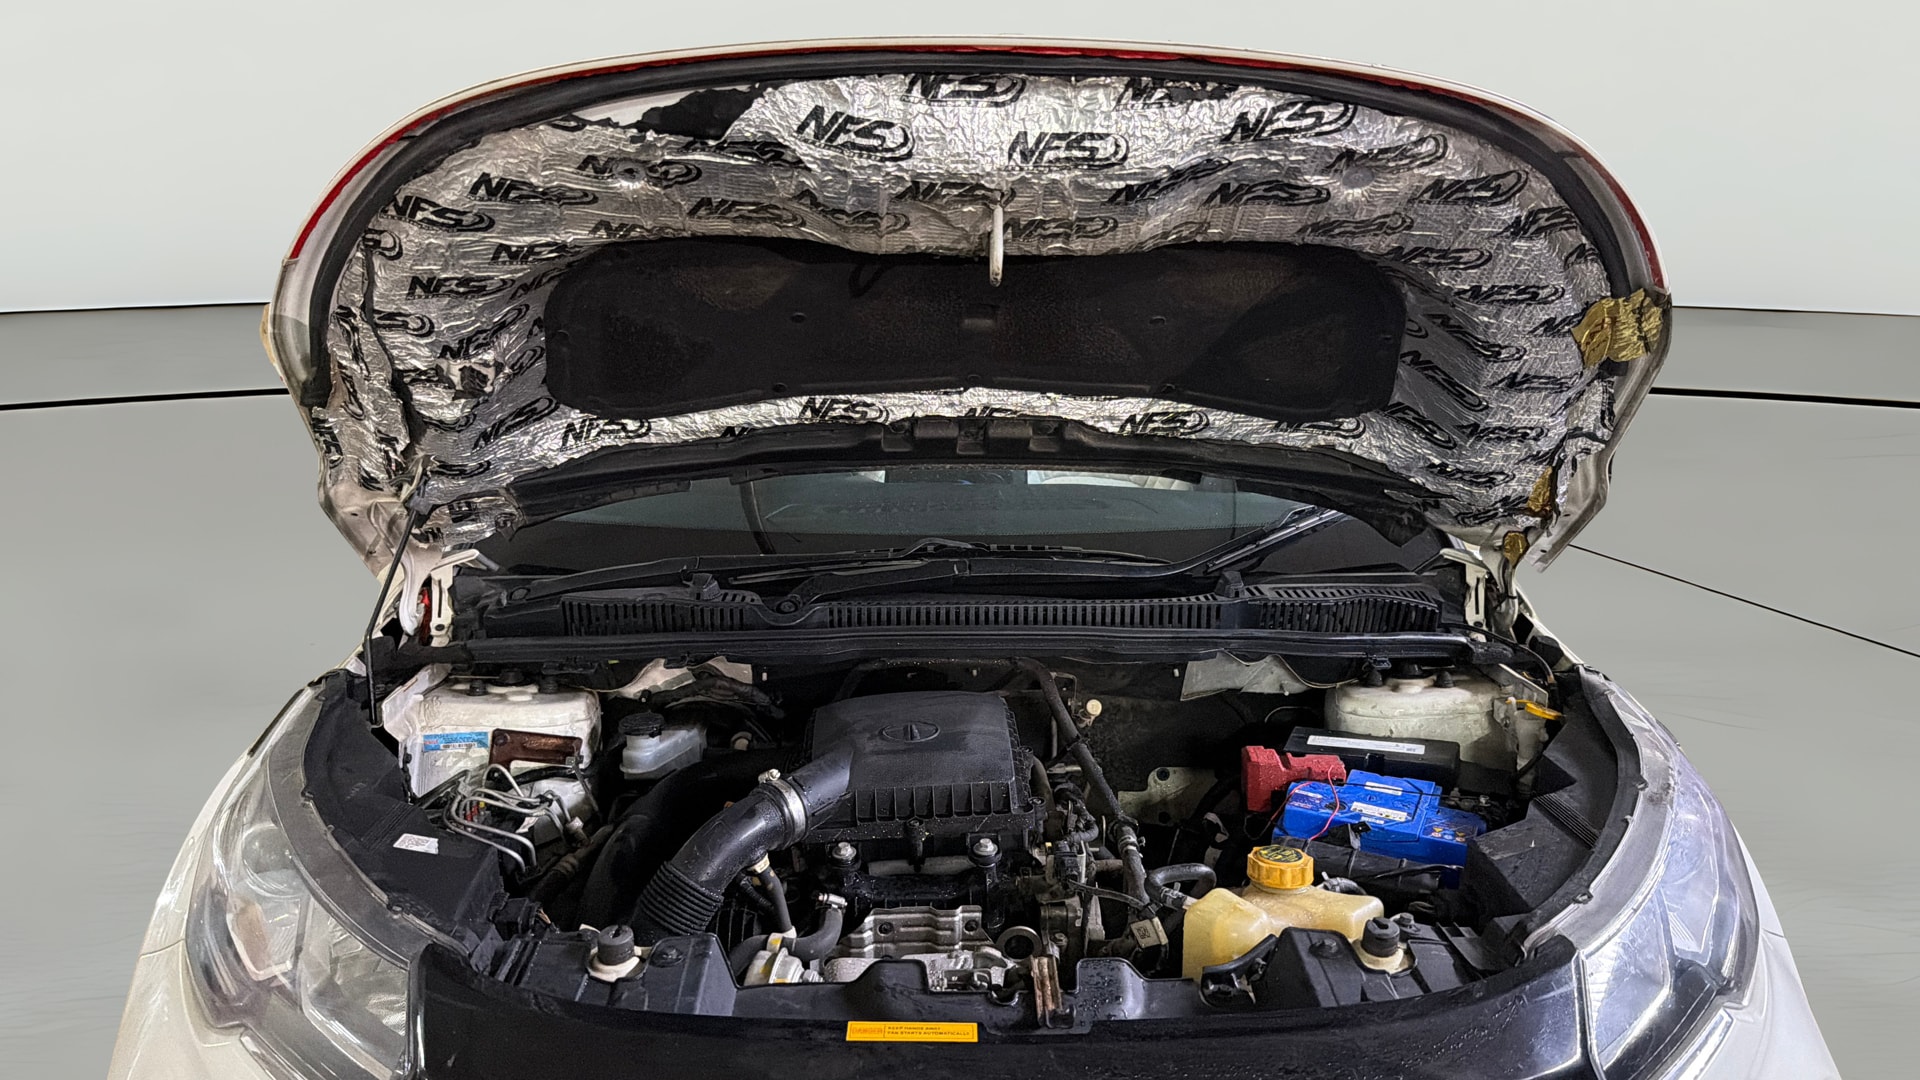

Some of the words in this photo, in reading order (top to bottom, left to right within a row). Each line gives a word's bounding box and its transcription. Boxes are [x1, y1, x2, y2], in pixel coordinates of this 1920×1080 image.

[904, 74, 1020, 103] NFS
[797, 106, 909, 158] NFS
[1221, 102, 1347, 142] NFS
[1008, 131, 1120, 166] NFS
[1413, 171, 1523, 203] NFS
[381, 196, 488, 232] NFS
[407, 276, 508, 298] NFS
[1454, 285, 1562, 304] NFS
[438, 306, 526, 359] NFS
[1401, 352, 1482, 411] NFS
[473, 398, 555, 450] NFS
[799, 397, 884, 422] NFS
[1118, 411, 1206, 434] NFS
[560, 409, 645, 451] NFS
